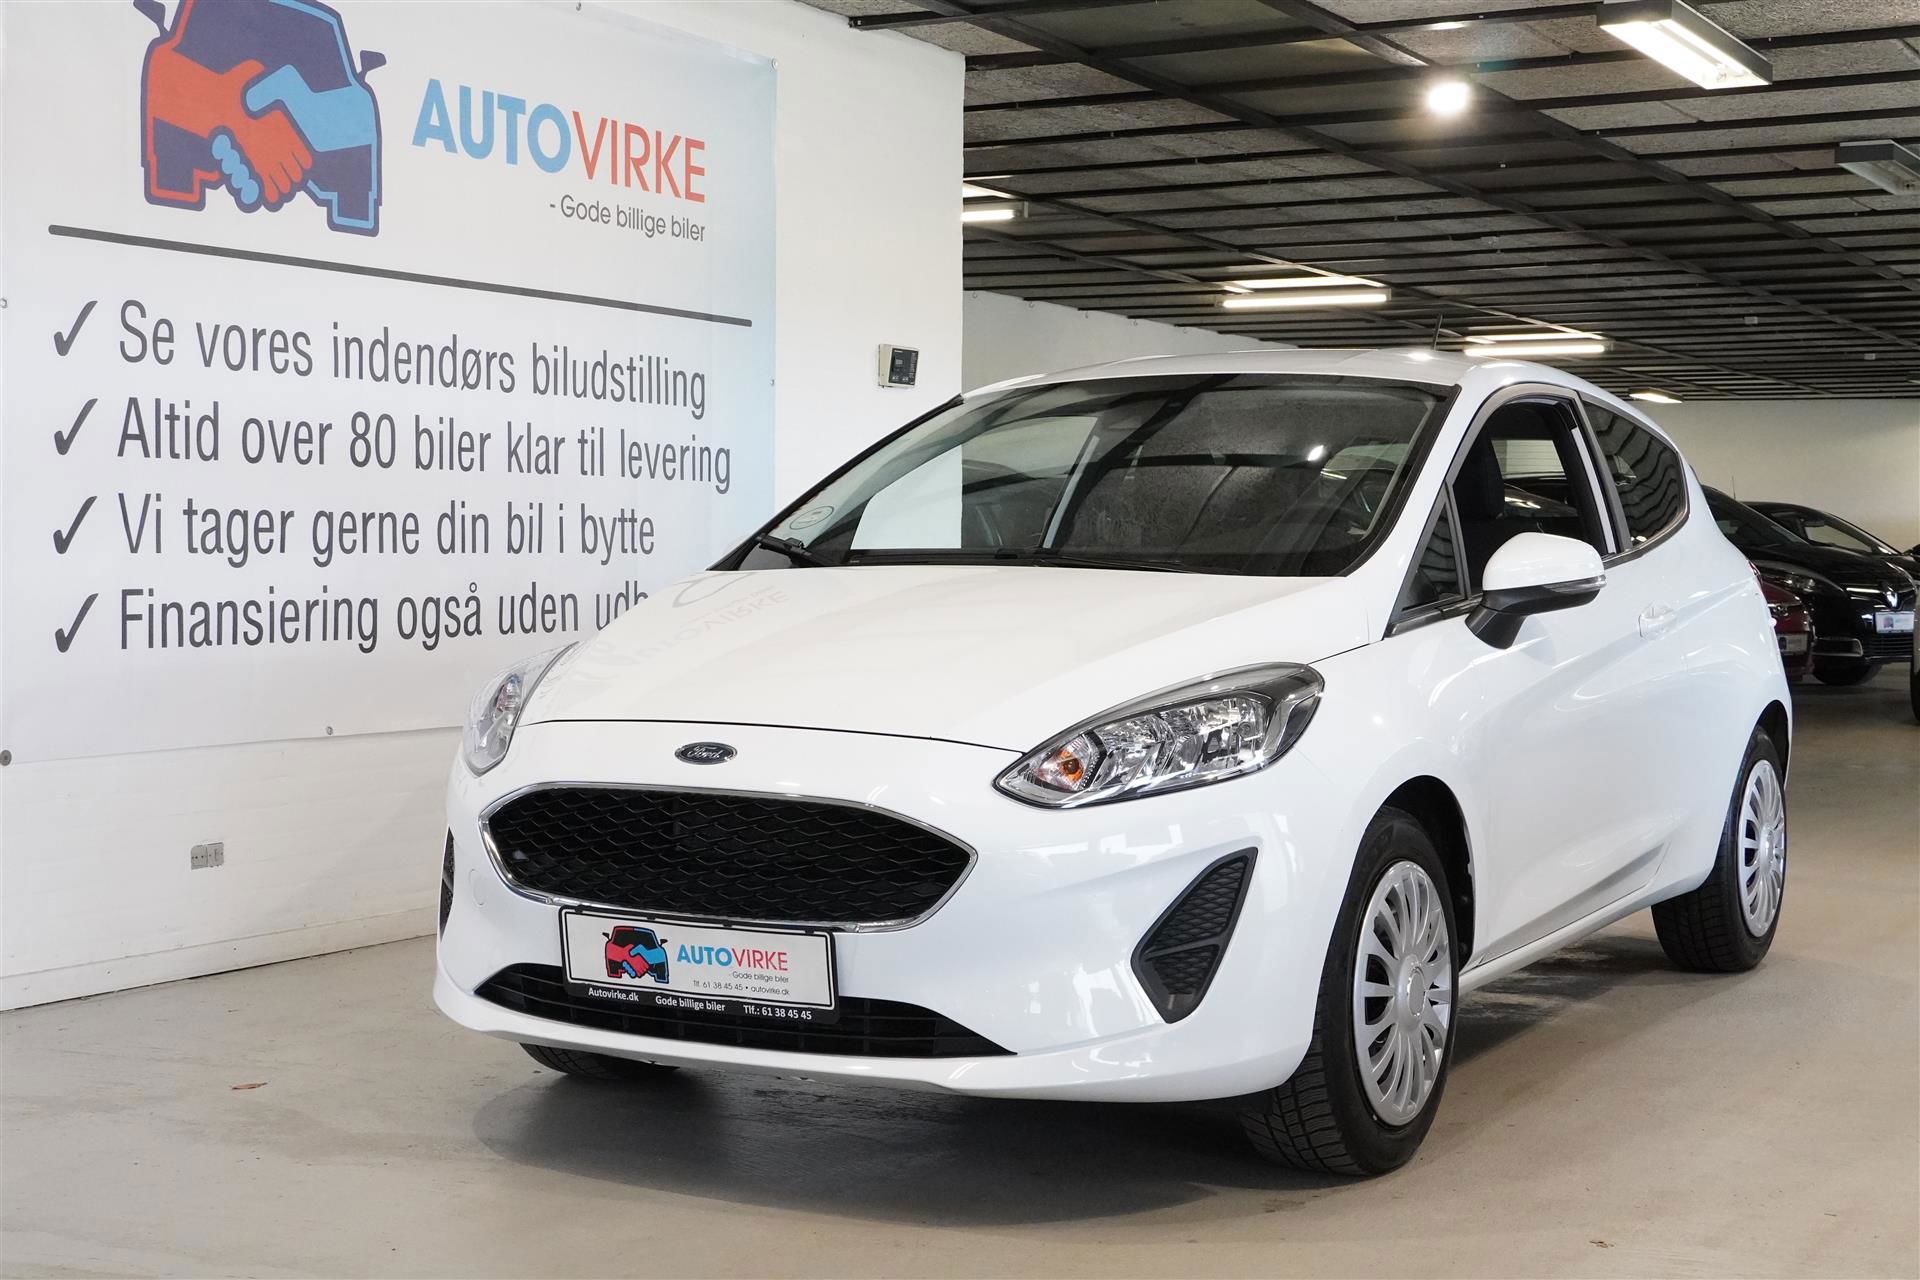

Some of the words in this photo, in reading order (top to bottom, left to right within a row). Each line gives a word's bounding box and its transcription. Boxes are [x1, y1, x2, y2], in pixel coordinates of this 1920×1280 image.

[412, 78, 706, 203] AUTOVIRKE
[560, 194, 611, 224] Gode
[616, 204, 666, 238] billige
[671, 215, 705, 241] biler
[119, 299, 175, 366] Se
[195, 322, 313, 377] vores
[332, 322, 516, 394] indendørs
[532, 342, 706, 420] biludstilling
[117, 396, 219, 462] Altid
[241, 417, 333, 466] over
[349, 411, 396, 469] 80
[414, 414, 492, 473] biler
[507, 421, 566, 475] klar
[577, 427, 604, 477] til
[620, 428, 731, 495] levering
[117, 492, 162, 554] Vi
[182, 498, 295, 569] tager
[312, 510, 420, 568] gerne
[437, 499, 489, 555] din
[507, 501, 543, 555] bil
[558, 502, 565, 554] i
[580, 502, 655, 566] bytte
[120, 584, 378, 654] Finansiering
[397, 581, 483, 652] også
[498, 581, 579, 636] uden
[677, 943, 789, 972] AUTOVIRKE
[588, 987, 640, 1002] Autovirke.dk
[702, 981, 711, 989] 61
[713, 982, 722, 990] 38
[723, 983, 733, 991] 45
[734, 983, 744, 992] 45
[732, 970, 752, 980] Gode
[754, 972, 774, 983] billige
[775, 975, 789, 984] biler
[655, 995, 678, 1007] Gode
[679, 997, 704, 1011] billige
[705, 1000, 726, 1012] biler
[743, 1004, 760, 1015] Tlf.:
[761, 1006, 773, 1017] 61
[774, 1007, 786, 1018] 38
[787, 1009, 799, 1019] 45
[800, 1010, 812, 1020] 45
